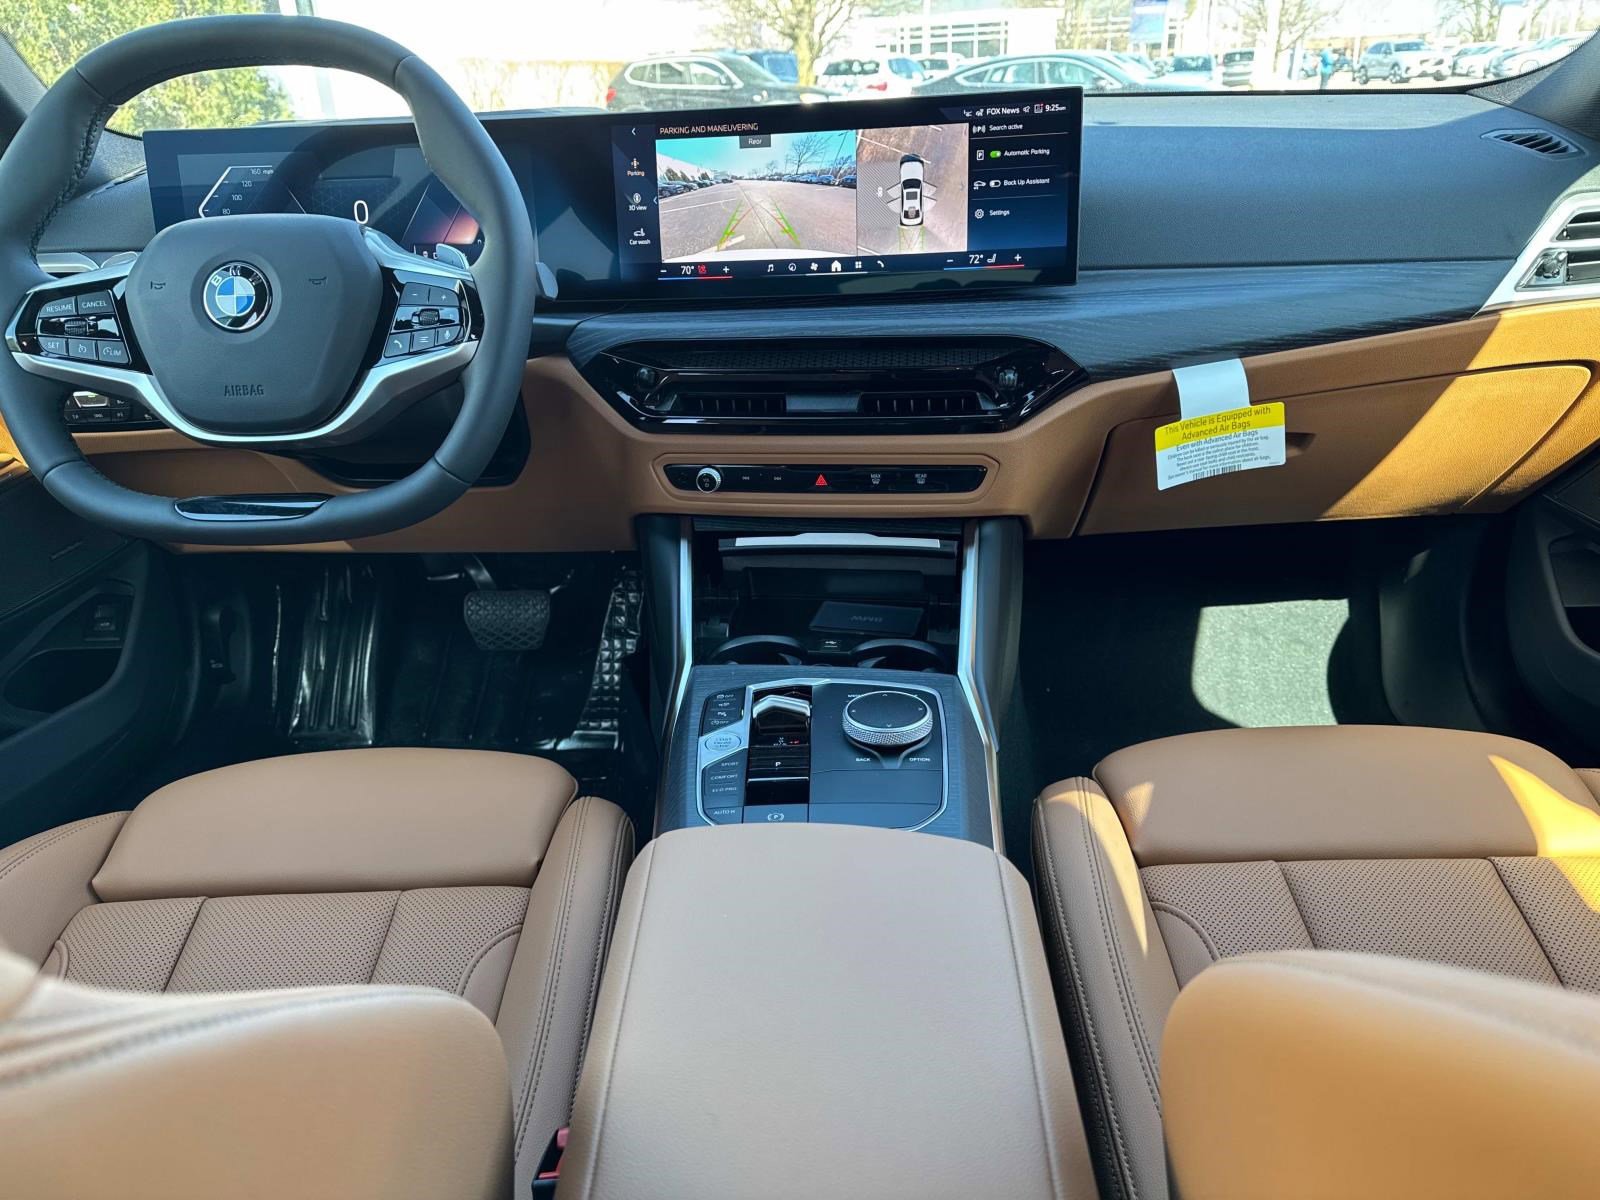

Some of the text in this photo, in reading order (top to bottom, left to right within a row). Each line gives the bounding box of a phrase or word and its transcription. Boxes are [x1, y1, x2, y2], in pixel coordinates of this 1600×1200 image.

[986, 106, 1020, 116] FOX News
[659, 122, 759, 135] PARKING AND MANEUVERING
[989, 123, 1023, 132] Search active
[1003, 148, 1050, 157] Automatic Parking
[241, 180, 253, 188] 120
[1003, 177, 1050, 187] Back Up Assistant
[353, 200, 369, 225] 0
[636, 204, 647, 212] view
[989, 209, 1010, 217] Settings
[638, 238, 651, 246] wash
[46, 303, 73, 313] RESUME
[81, 300, 107, 309] CANCEL
[47, 341, 60, 349] SET
[109, 348, 122, 356] LIM
[223, 384, 265, 397] AIRBAG
[1165, 406, 1271, 436] This Vehicle is Equipped with
[1181, 419, 1251, 441] Advanced Air Bags
[1204, 432, 1233, 446] Advanced
[1242, 429, 1259, 439] Bags
